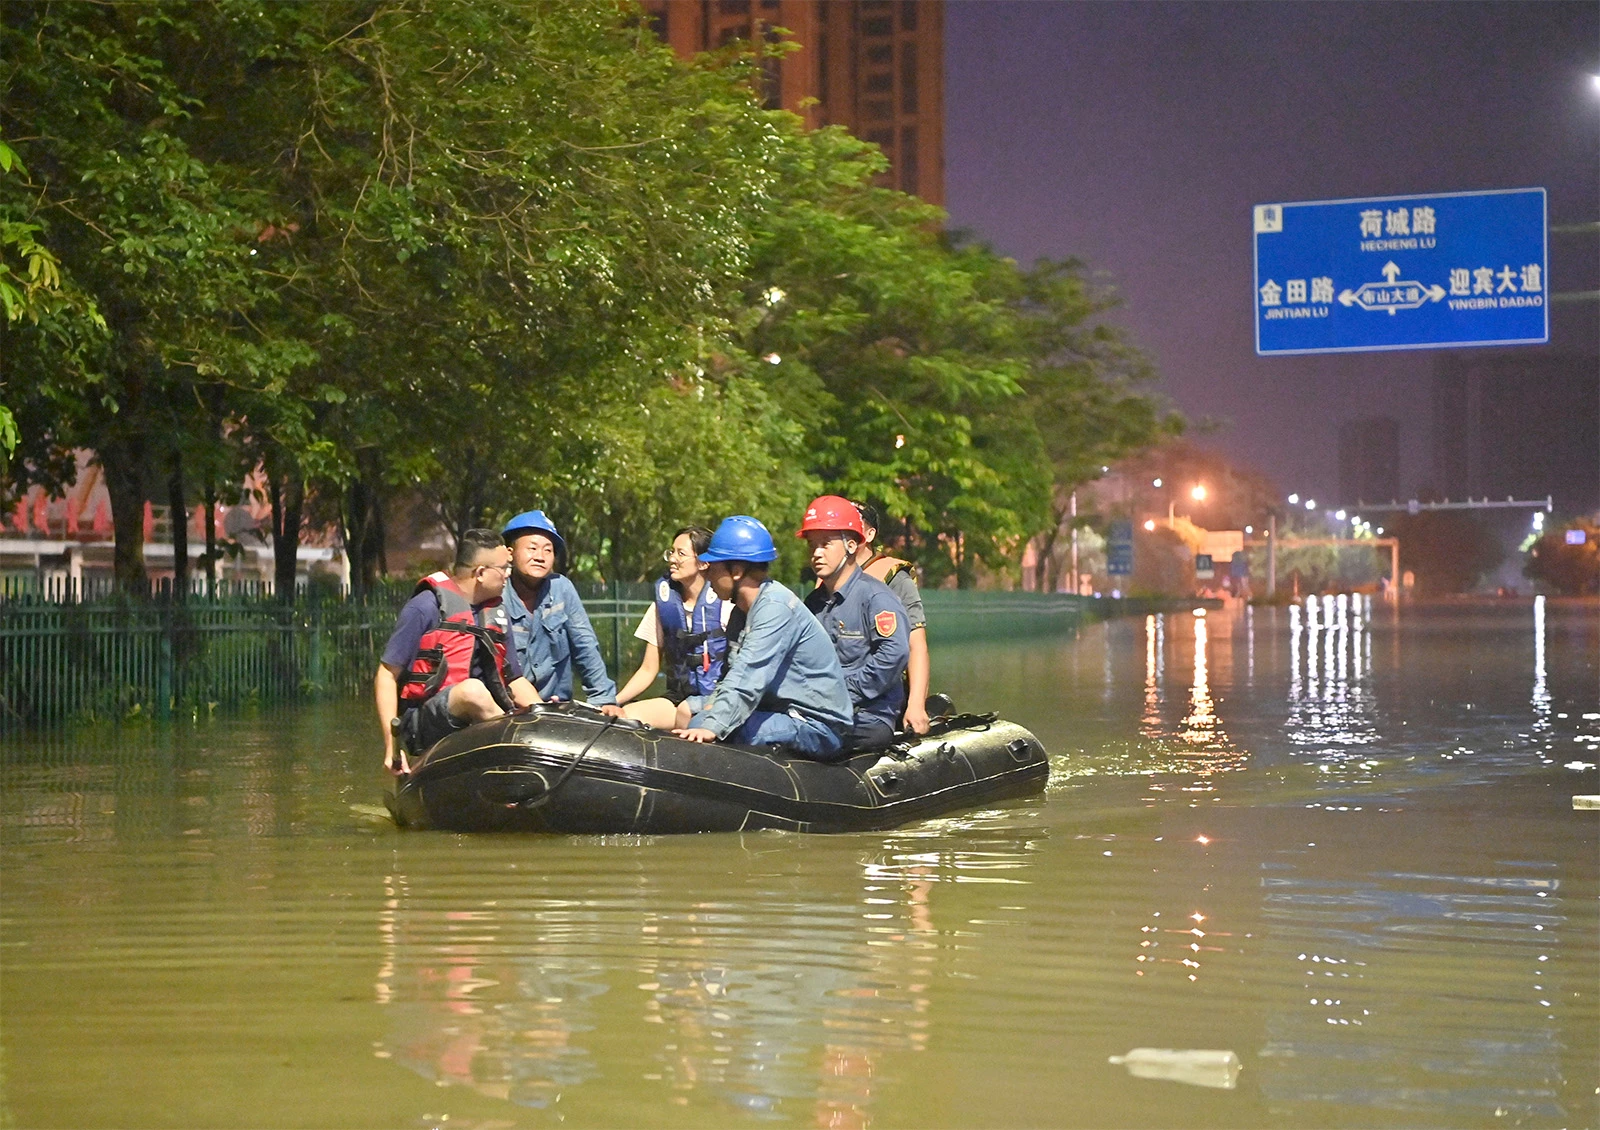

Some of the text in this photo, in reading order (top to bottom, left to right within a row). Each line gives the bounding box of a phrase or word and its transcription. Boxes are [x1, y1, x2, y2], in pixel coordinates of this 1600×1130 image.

[1360, 206, 1436, 238] 荷城路
[1361, 238, 1436, 251] HECHENG LU
[1449, 264, 1542, 296] 迎宾大道
[1260, 277, 1334, 306] 金田路
[1264, 307, 1329, 320] JINTIAN LU
[1448, 297, 1543, 310] YINGBIN DADAO
